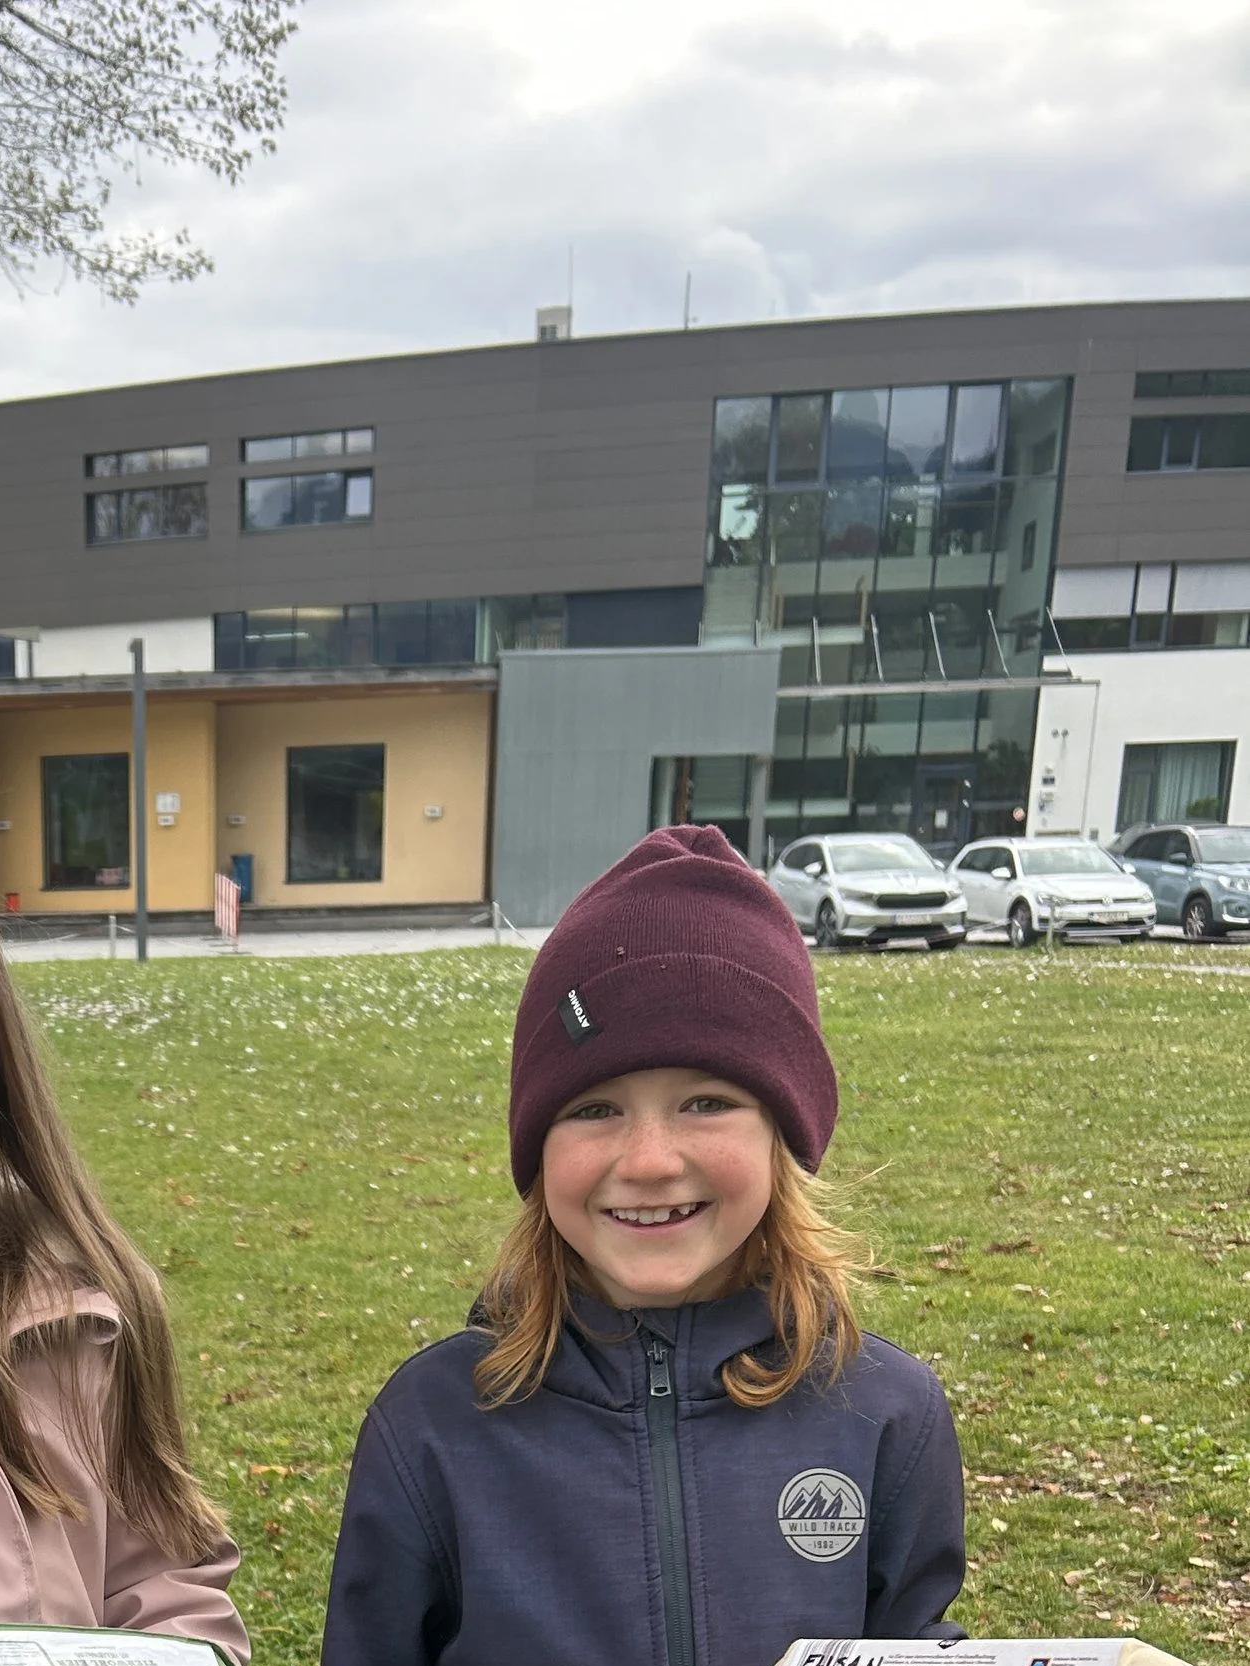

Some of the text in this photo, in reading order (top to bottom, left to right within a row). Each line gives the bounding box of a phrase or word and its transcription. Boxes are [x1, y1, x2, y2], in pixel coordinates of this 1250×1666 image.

[567, 989, 591, 1028] ATOMIC
[788, 1521, 858, 1532] WILD TRACK
